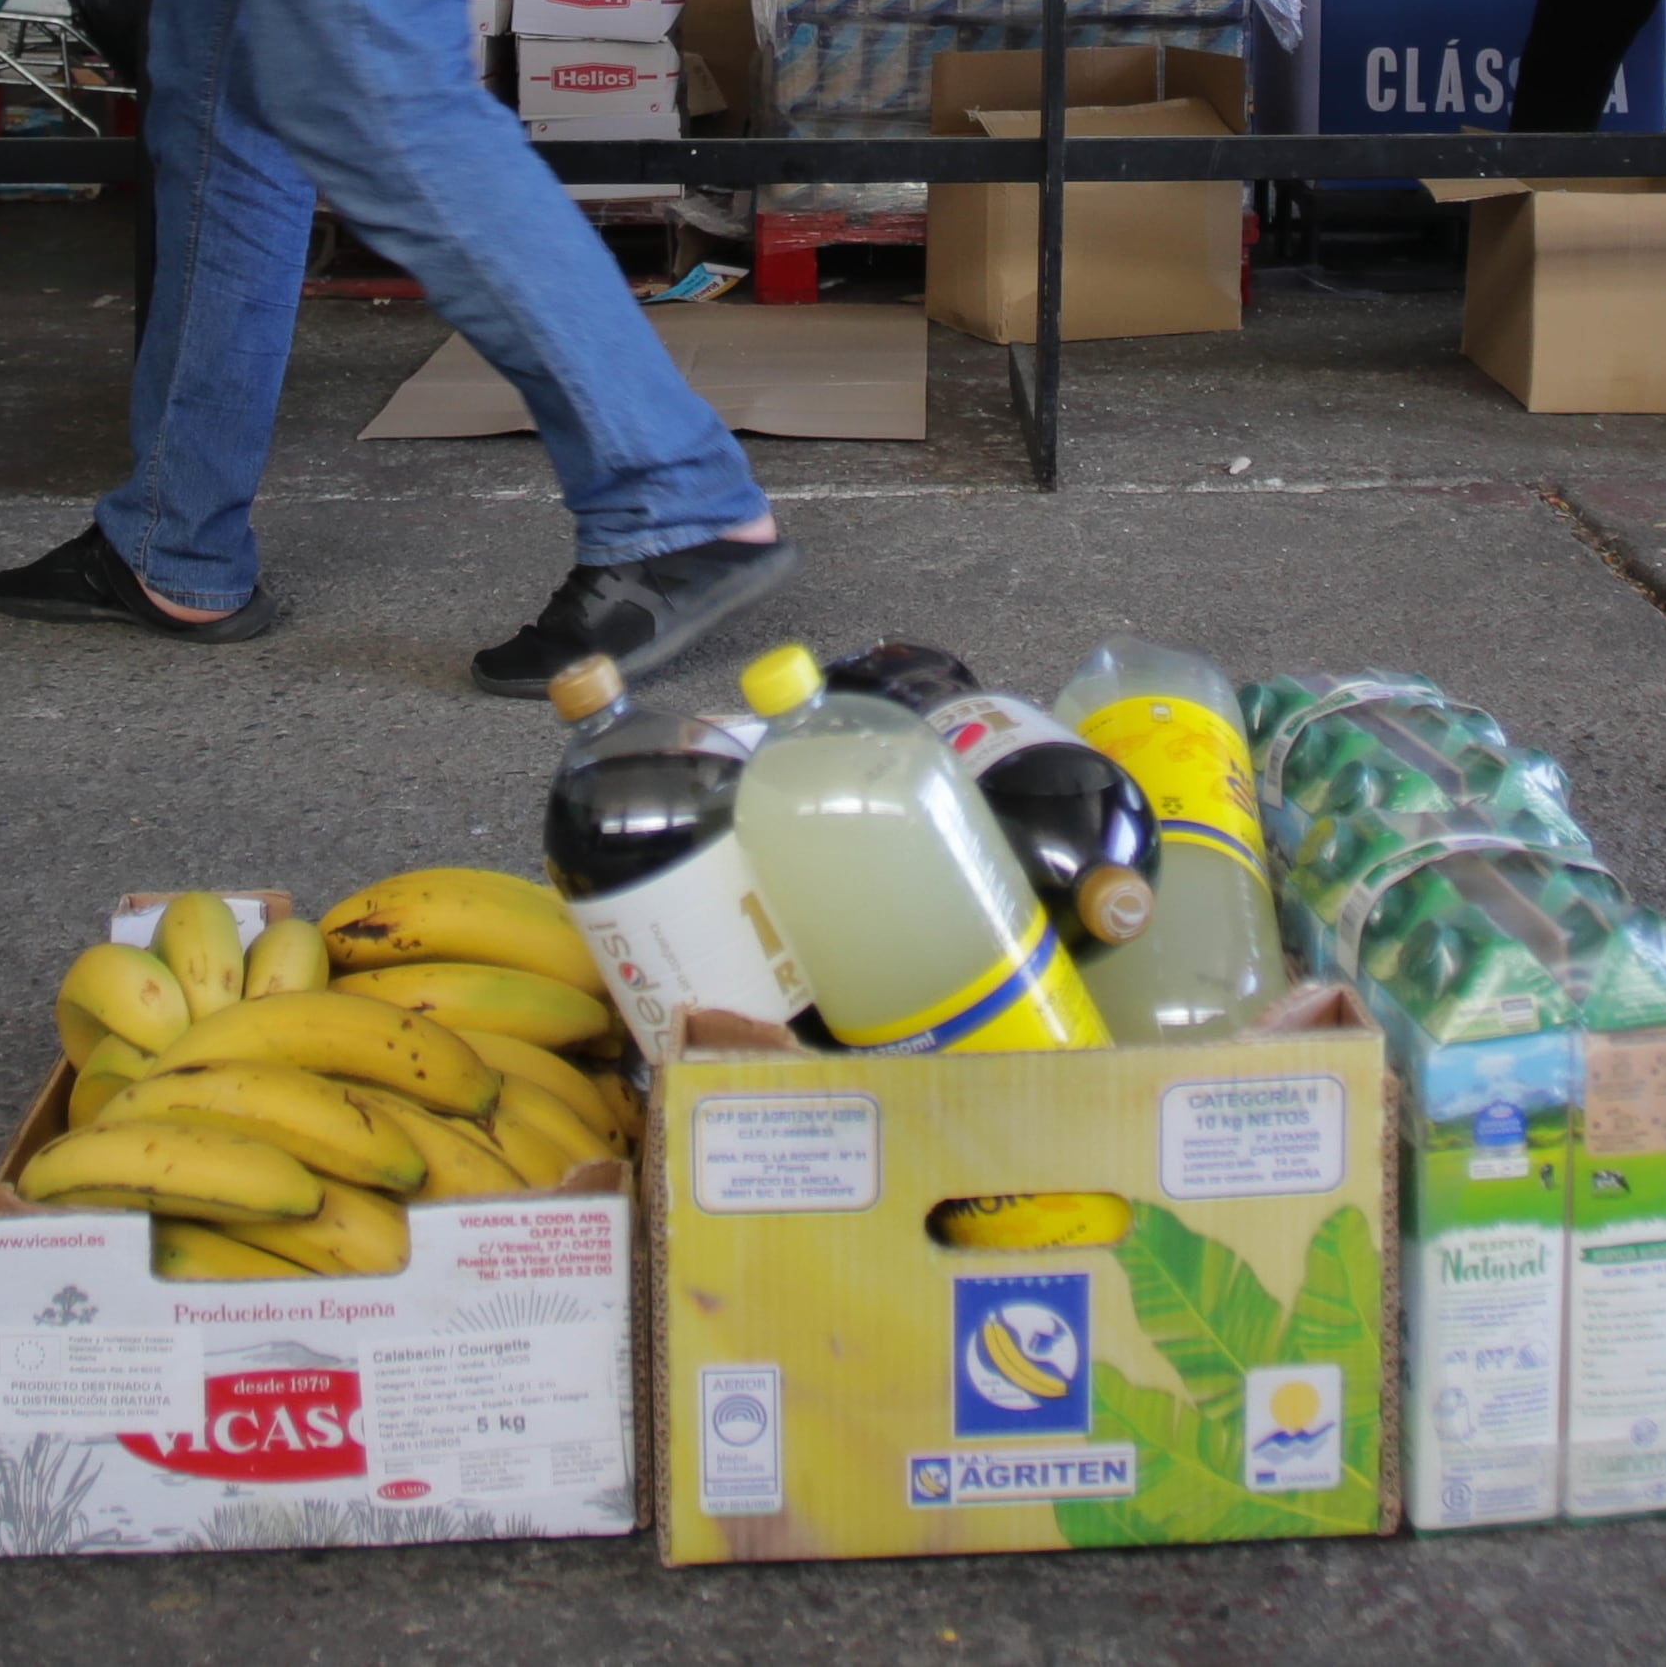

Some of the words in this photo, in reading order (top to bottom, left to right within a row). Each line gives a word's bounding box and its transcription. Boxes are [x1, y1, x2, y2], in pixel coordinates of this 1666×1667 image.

[558, 70, 630, 87] Helios
[1189, 1088, 1300, 1109] CATEGORÍA
[1197, 1115, 1216, 1130] 10
[1222, 1115, 1243, 1132] kg
[1248, 1110, 1311, 1126] NETOS
[459, 1215, 516, 1228] VICASOL
[502, 1256, 517, 1265] de
[1442, 1243, 1547, 1286] Natural
[174, 1302, 283, 1324] Producido
[288, 1305, 314, 1320] en
[319, 1298, 396, 1324] España
[458, 1339, 531, 1356] Courgette
[11, 1381, 78, 1392] PRODUCTO
[82, 1381, 151, 1392] DESTINADO
[154, 1381, 163, 1391] A
[234, 1373, 284, 1396] desde
[290, 1366, 331, 1392] 1979
[713, 1379, 767, 1391] AENOR
[3, 1396, 19, 1406] SU
[22, 1394, 107, 1407] DISTRIBUCIÓN
[111, 1395, 171, 1406] GRATUITA
[477, 1416, 489, 1433] 5
[499, 1413, 526, 1433] kg
[959, 1460, 1127, 1490] AGRITEN
